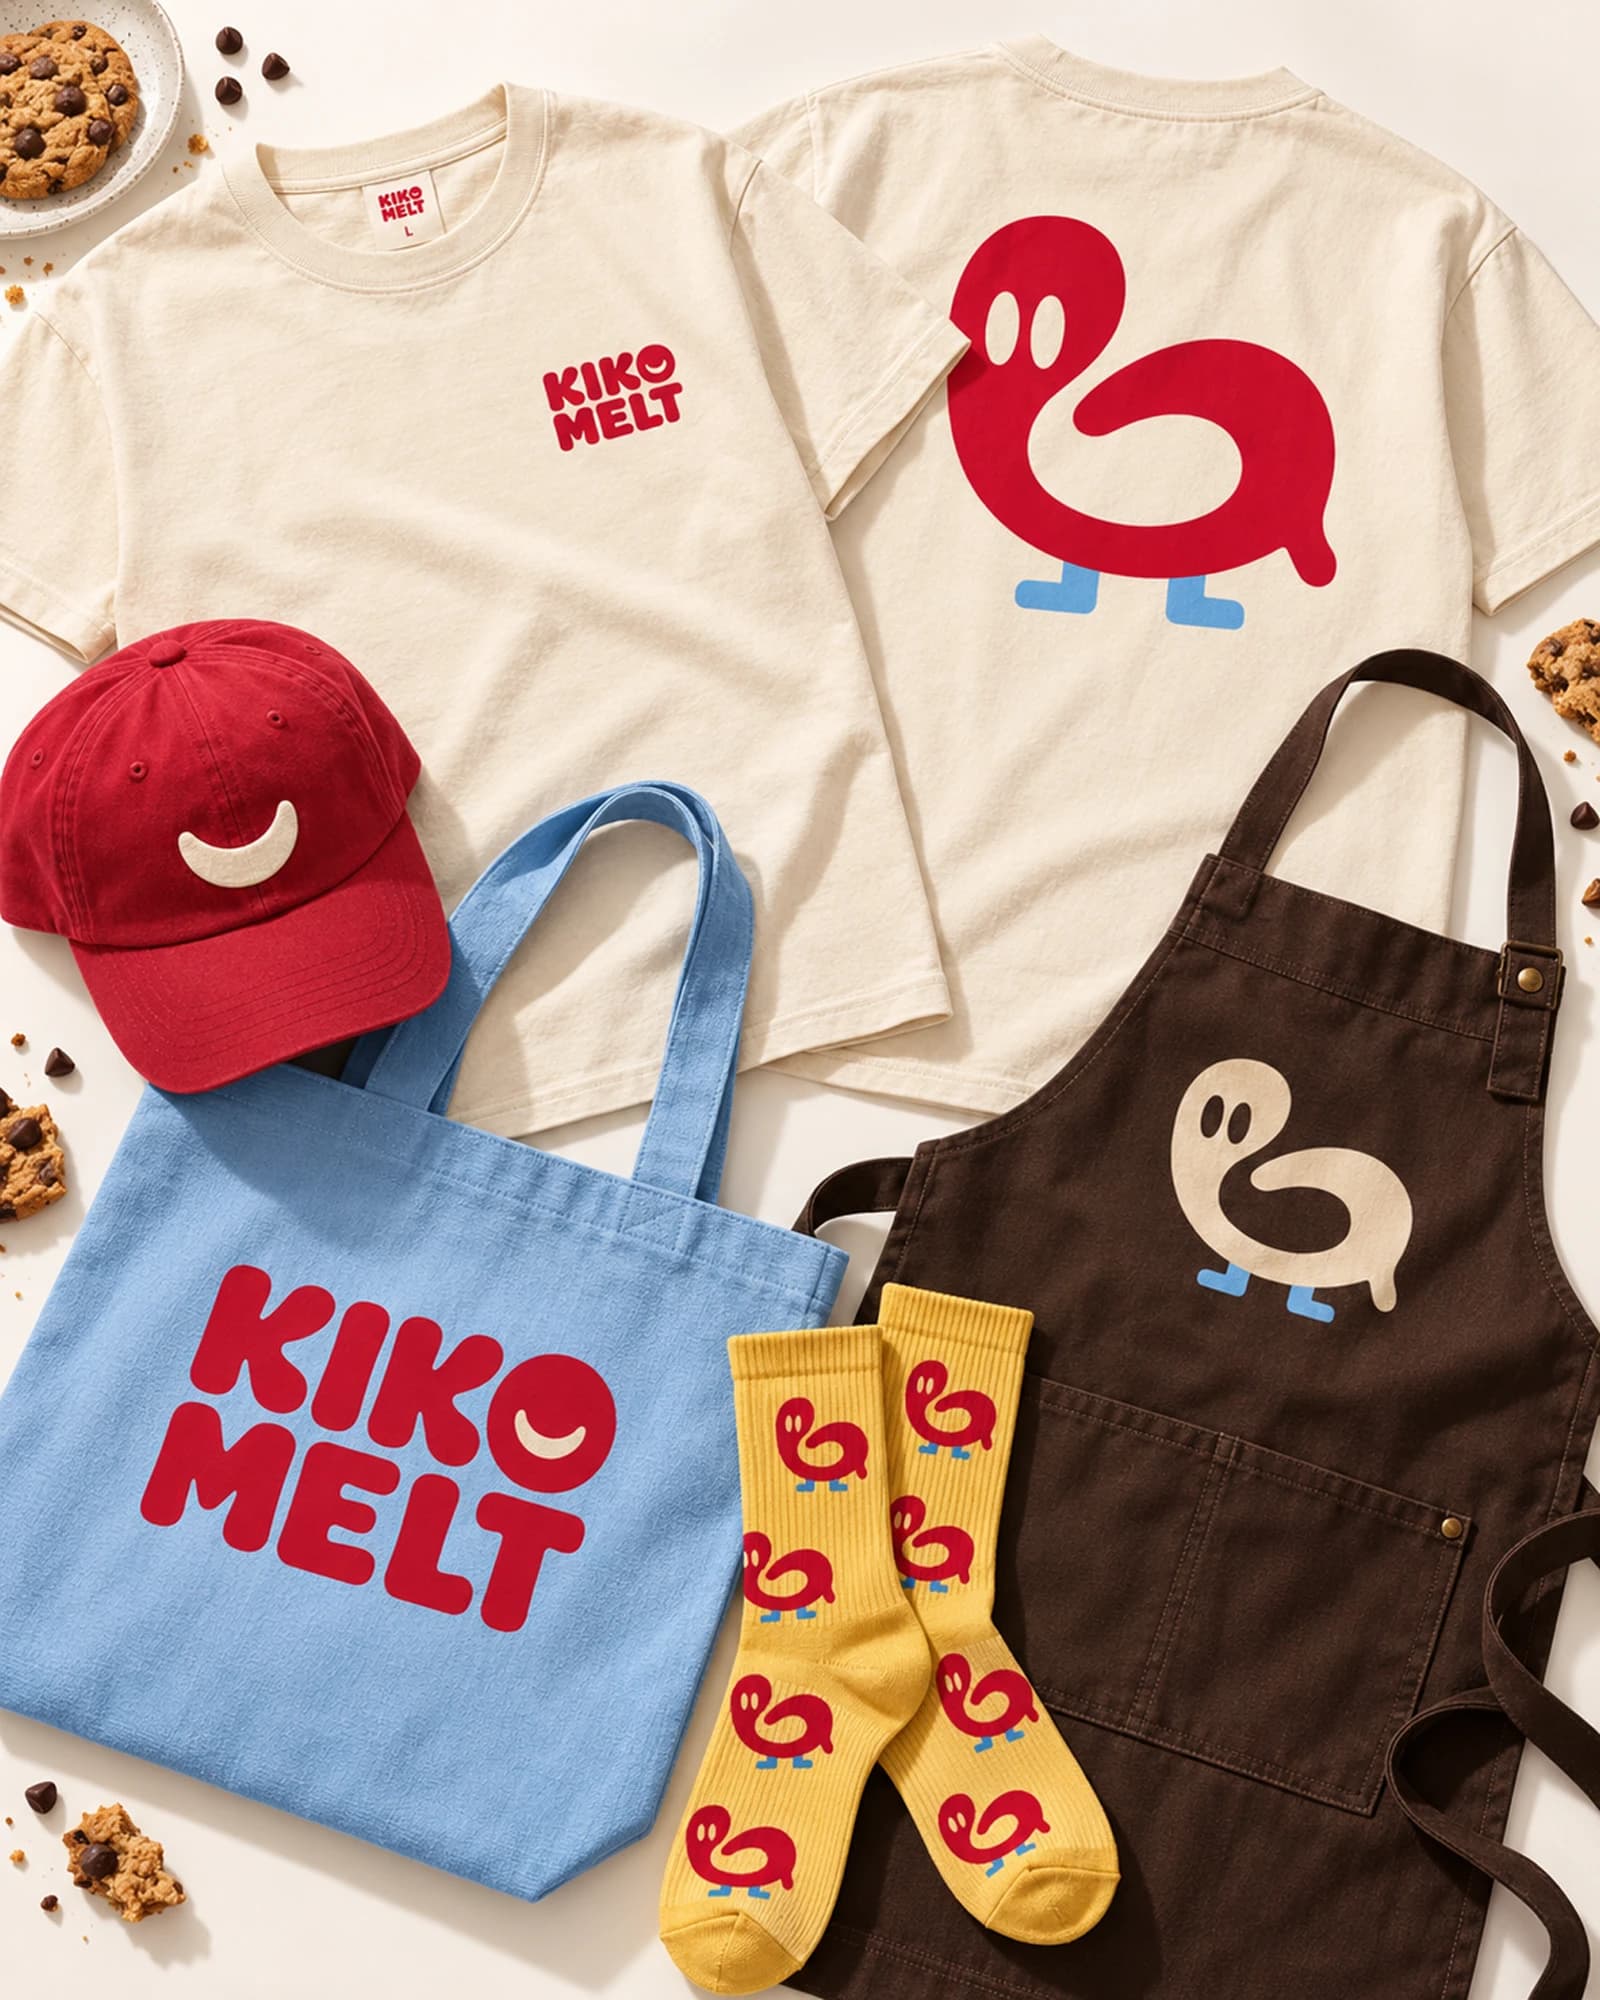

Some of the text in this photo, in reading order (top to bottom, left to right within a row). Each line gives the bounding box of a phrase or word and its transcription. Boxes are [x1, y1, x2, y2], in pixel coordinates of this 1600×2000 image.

[378, 186, 422, 208] KIKO
[381, 199, 424, 222] MELT
[404, 226, 414, 237] L
[543, 344, 676, 412] KIKO
[553, 382, 683, 452] MELT
[190, 1264, 617, 1494] KIKO
[140, 1402, 586, 1633] MELT
